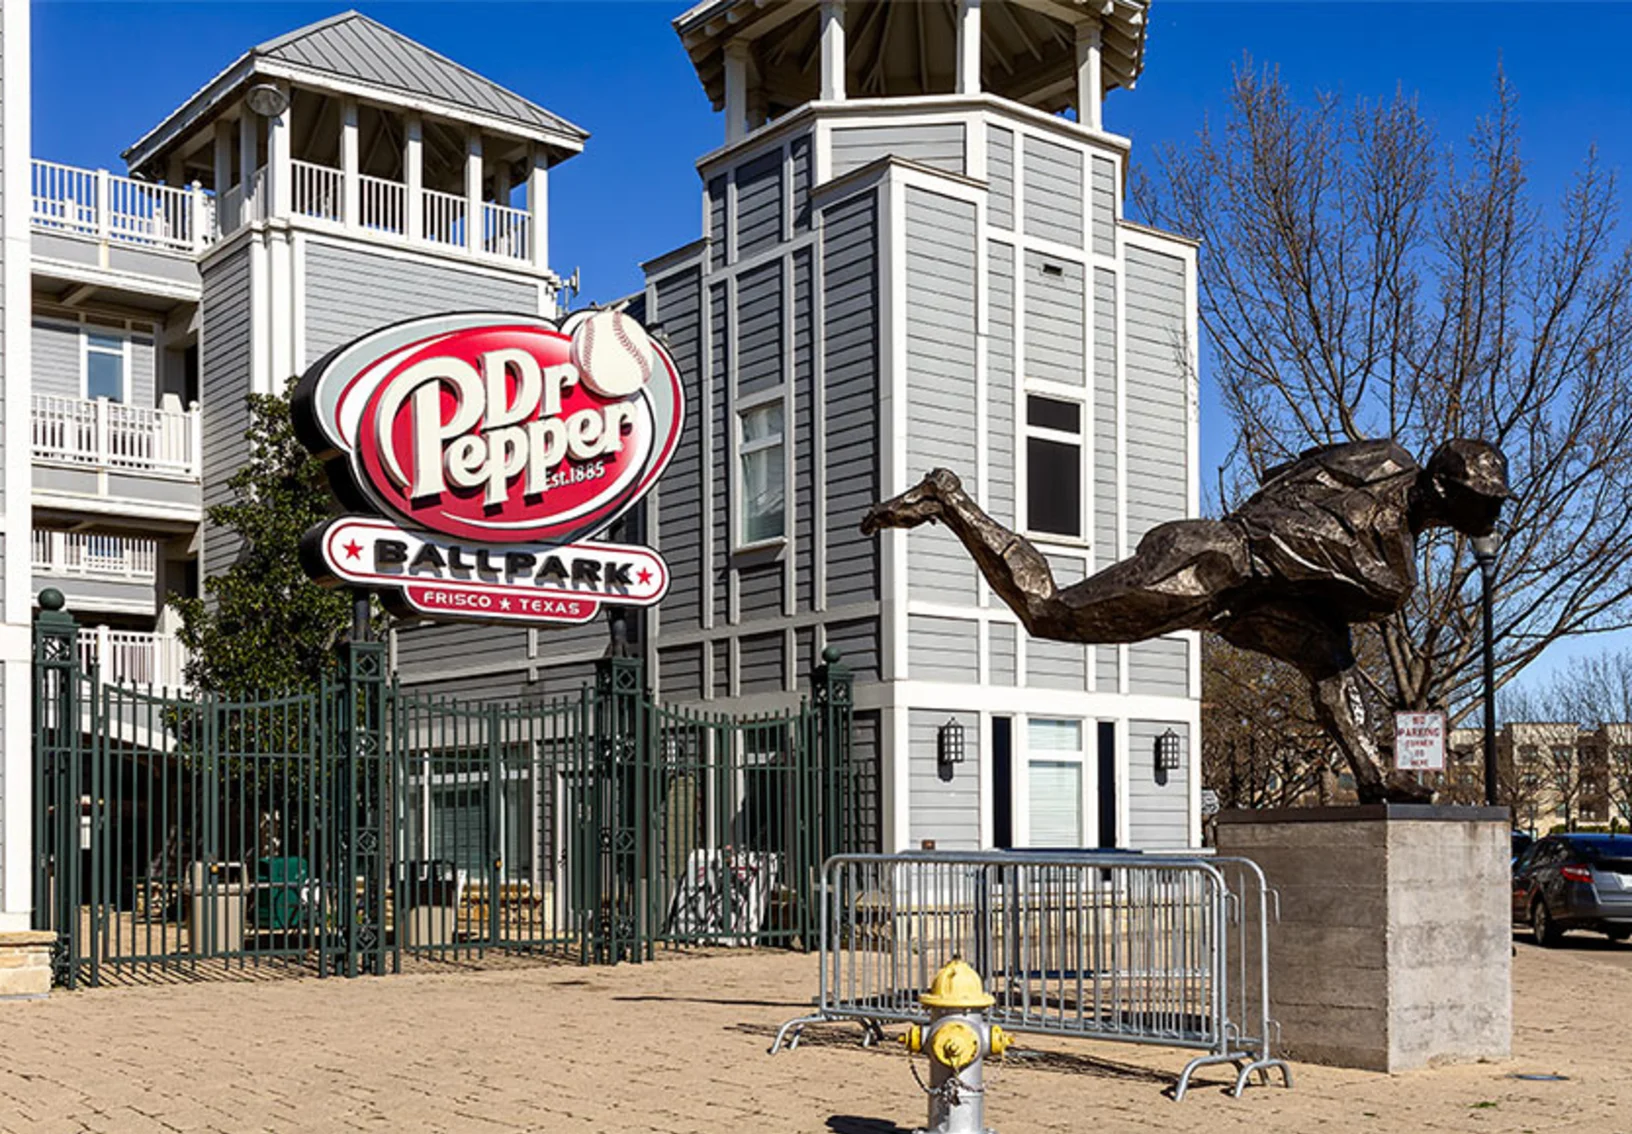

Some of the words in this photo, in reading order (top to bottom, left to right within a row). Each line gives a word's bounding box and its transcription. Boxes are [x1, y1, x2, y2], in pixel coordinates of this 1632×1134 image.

[478, 348, 580, 429] Dr
[375, 356, 638, 507] Pepper
[373, 538, 634, 588] BALLPARK
[423, 591, 492, 609] FRISCO
[519, 598, 581, 615] TEXAS
[1397, 727, 1440, 738] PARKING
